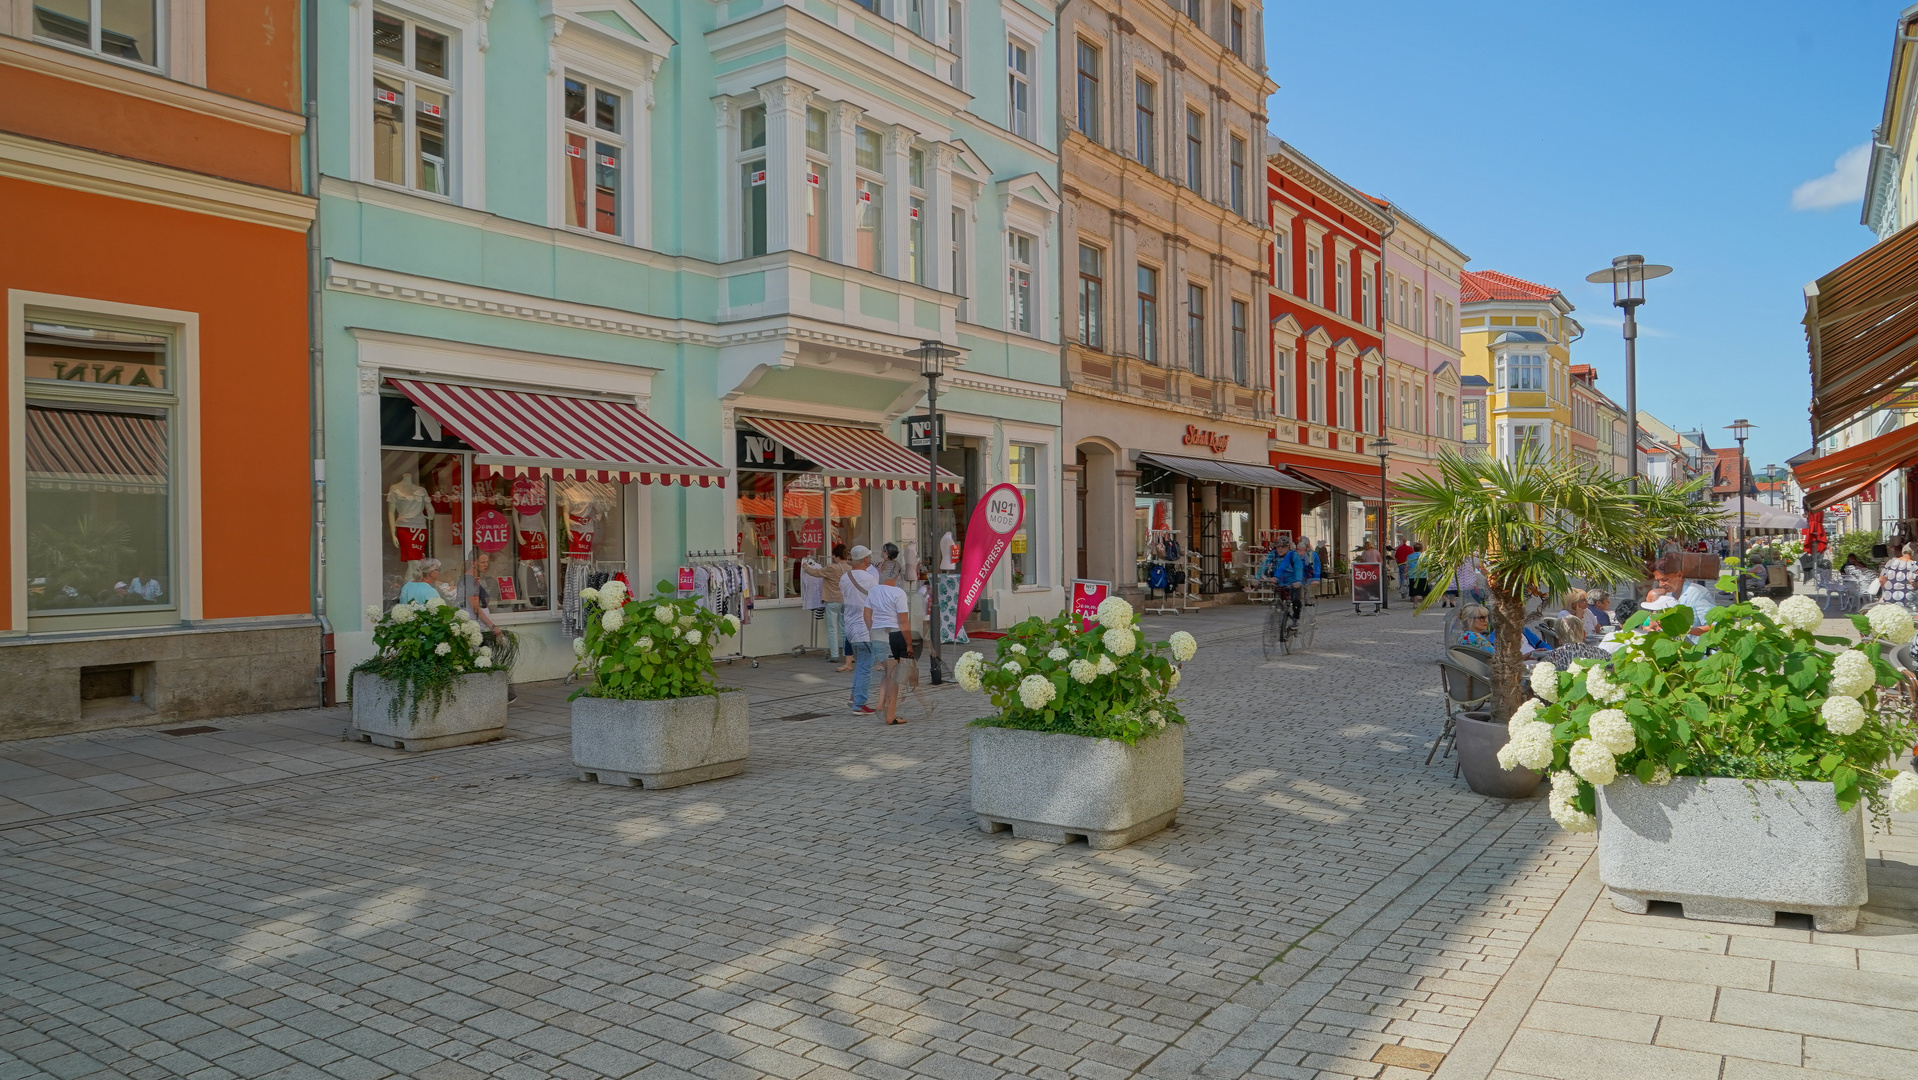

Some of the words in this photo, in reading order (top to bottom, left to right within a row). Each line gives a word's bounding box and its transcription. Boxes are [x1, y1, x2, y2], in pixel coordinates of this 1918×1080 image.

[513, 493, 544, 506] SALE
[989, 514, 1013, 526] MODE
[475, 530, 507, 543] SALE
[802, 532, 822, 543] SALE
[964, 578, 982, 606] MODE
[978, 539, 1005, 579] EXPRESS
[1355, 571, 1377, 580] 50%
